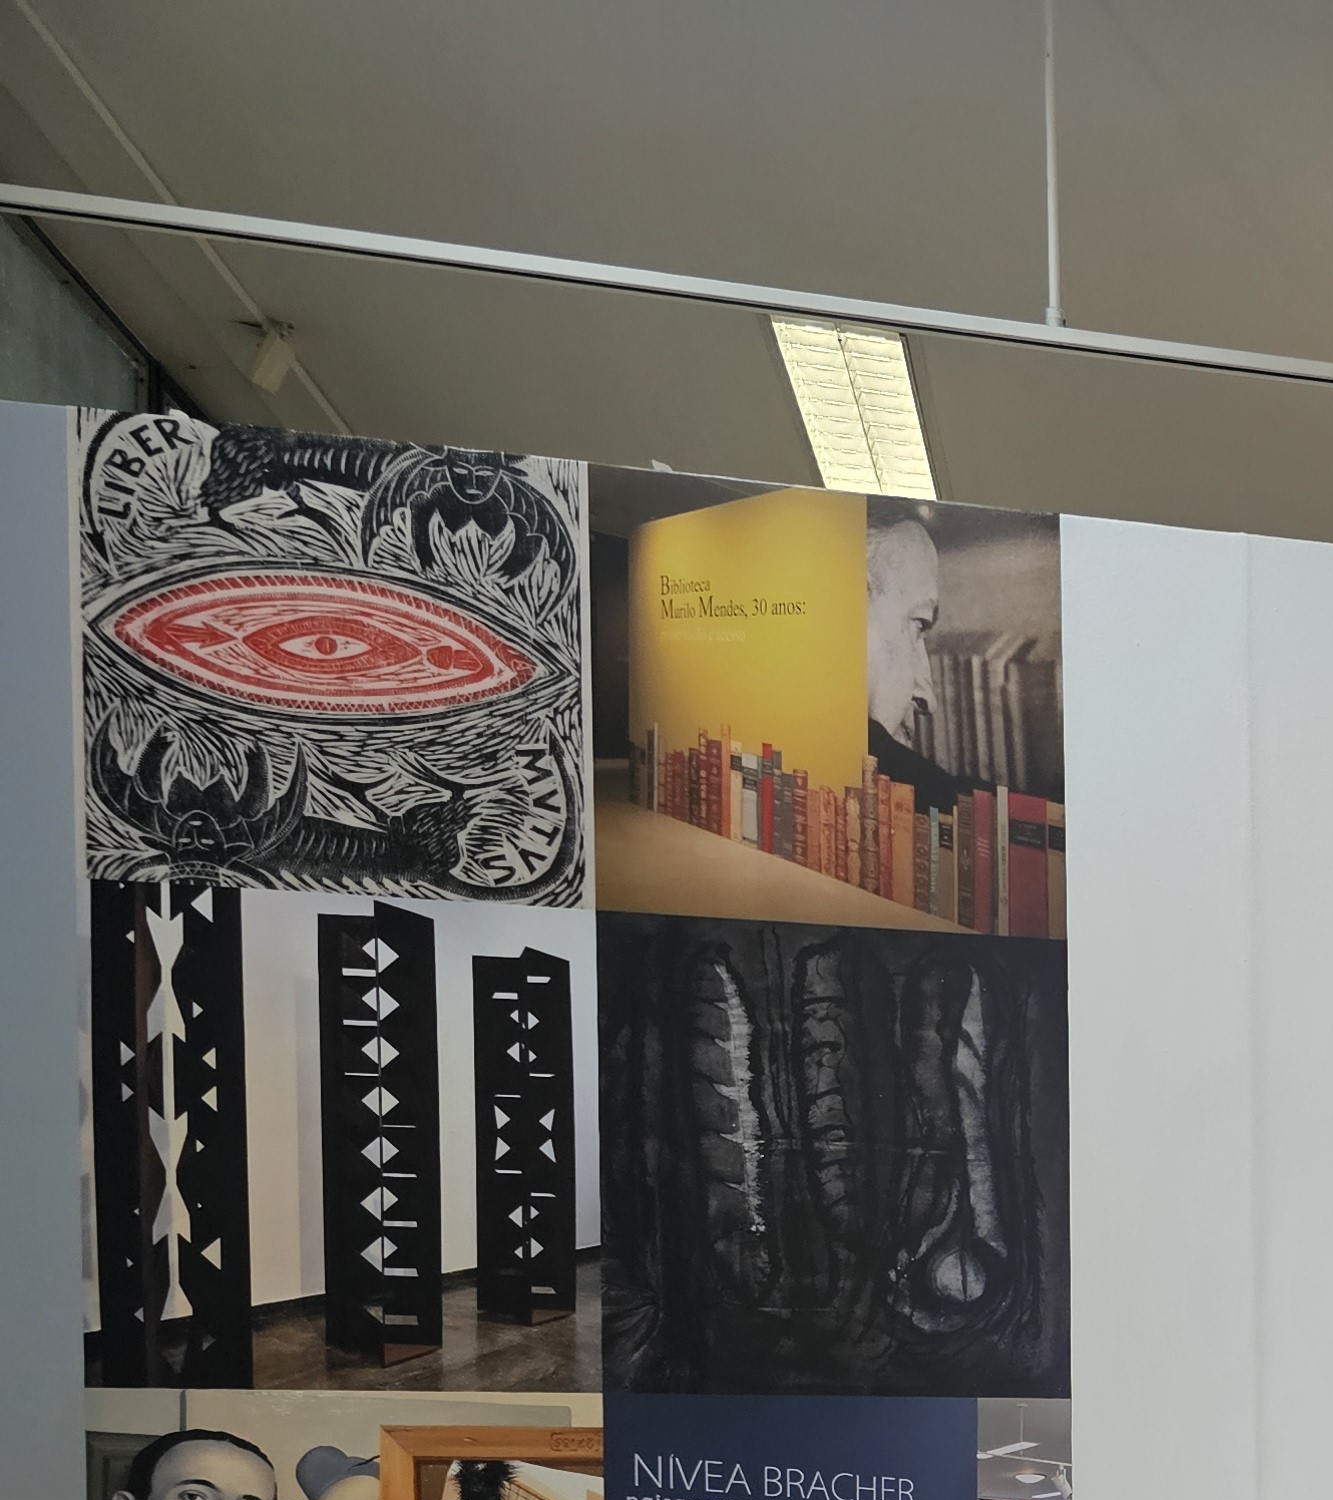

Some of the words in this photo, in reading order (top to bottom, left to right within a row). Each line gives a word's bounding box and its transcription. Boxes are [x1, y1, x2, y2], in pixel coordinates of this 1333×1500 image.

[97, 419, 196, 520] LIBER
[659, 574, 711, 597] Biblioteca
[660, 598, 697, 620] Murilo
[698, 595, 749, 619] Mendes,
[751, 598, 768, 617] 30
[771, 600, 807, 616] anos:
[633, 1452, 752, 1496] NÍVEA
